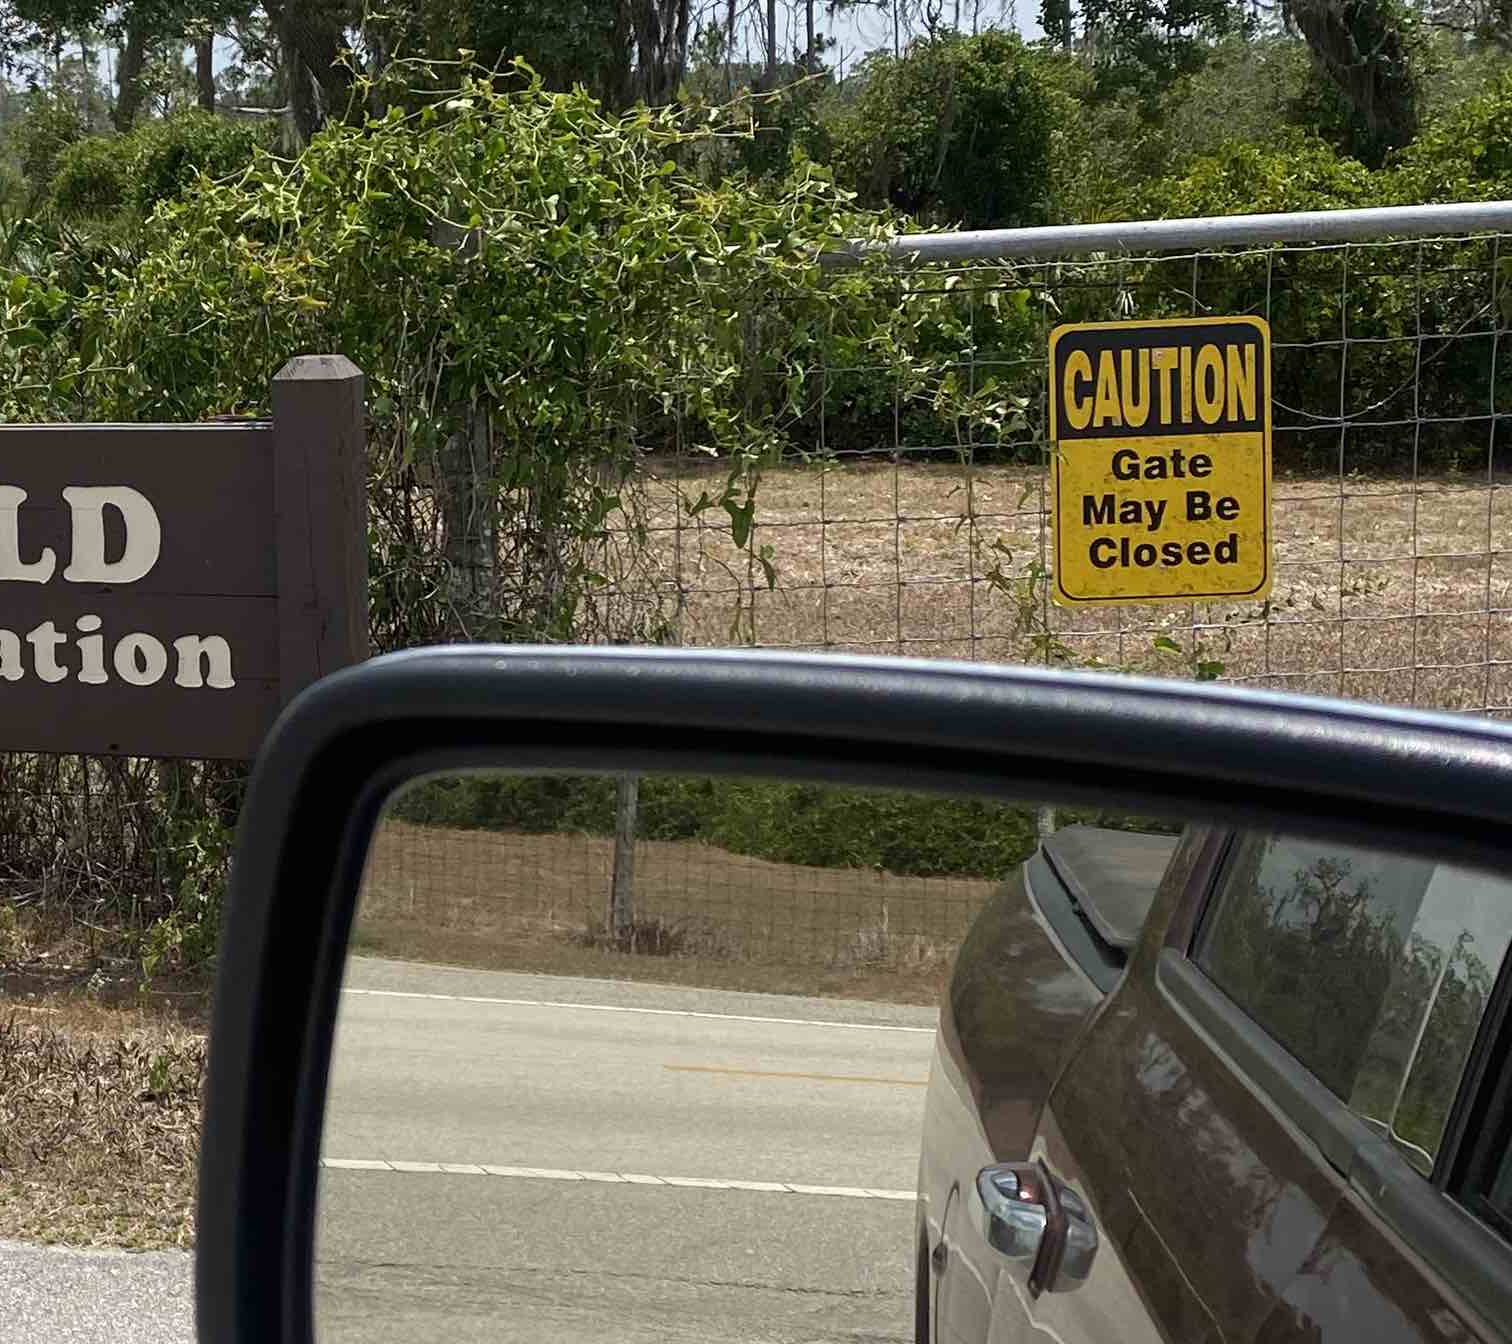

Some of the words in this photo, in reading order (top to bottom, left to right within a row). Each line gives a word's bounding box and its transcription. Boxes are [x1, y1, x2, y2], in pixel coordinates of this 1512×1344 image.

[1063, 343, 1256, 430] CAUTION
[1111, 448, 1213, 481] Gate
[1082, 493, 1168, 532] May
[1185, 490, 1241, 523] Be
[1088, 532, 1239, 569] Closed
